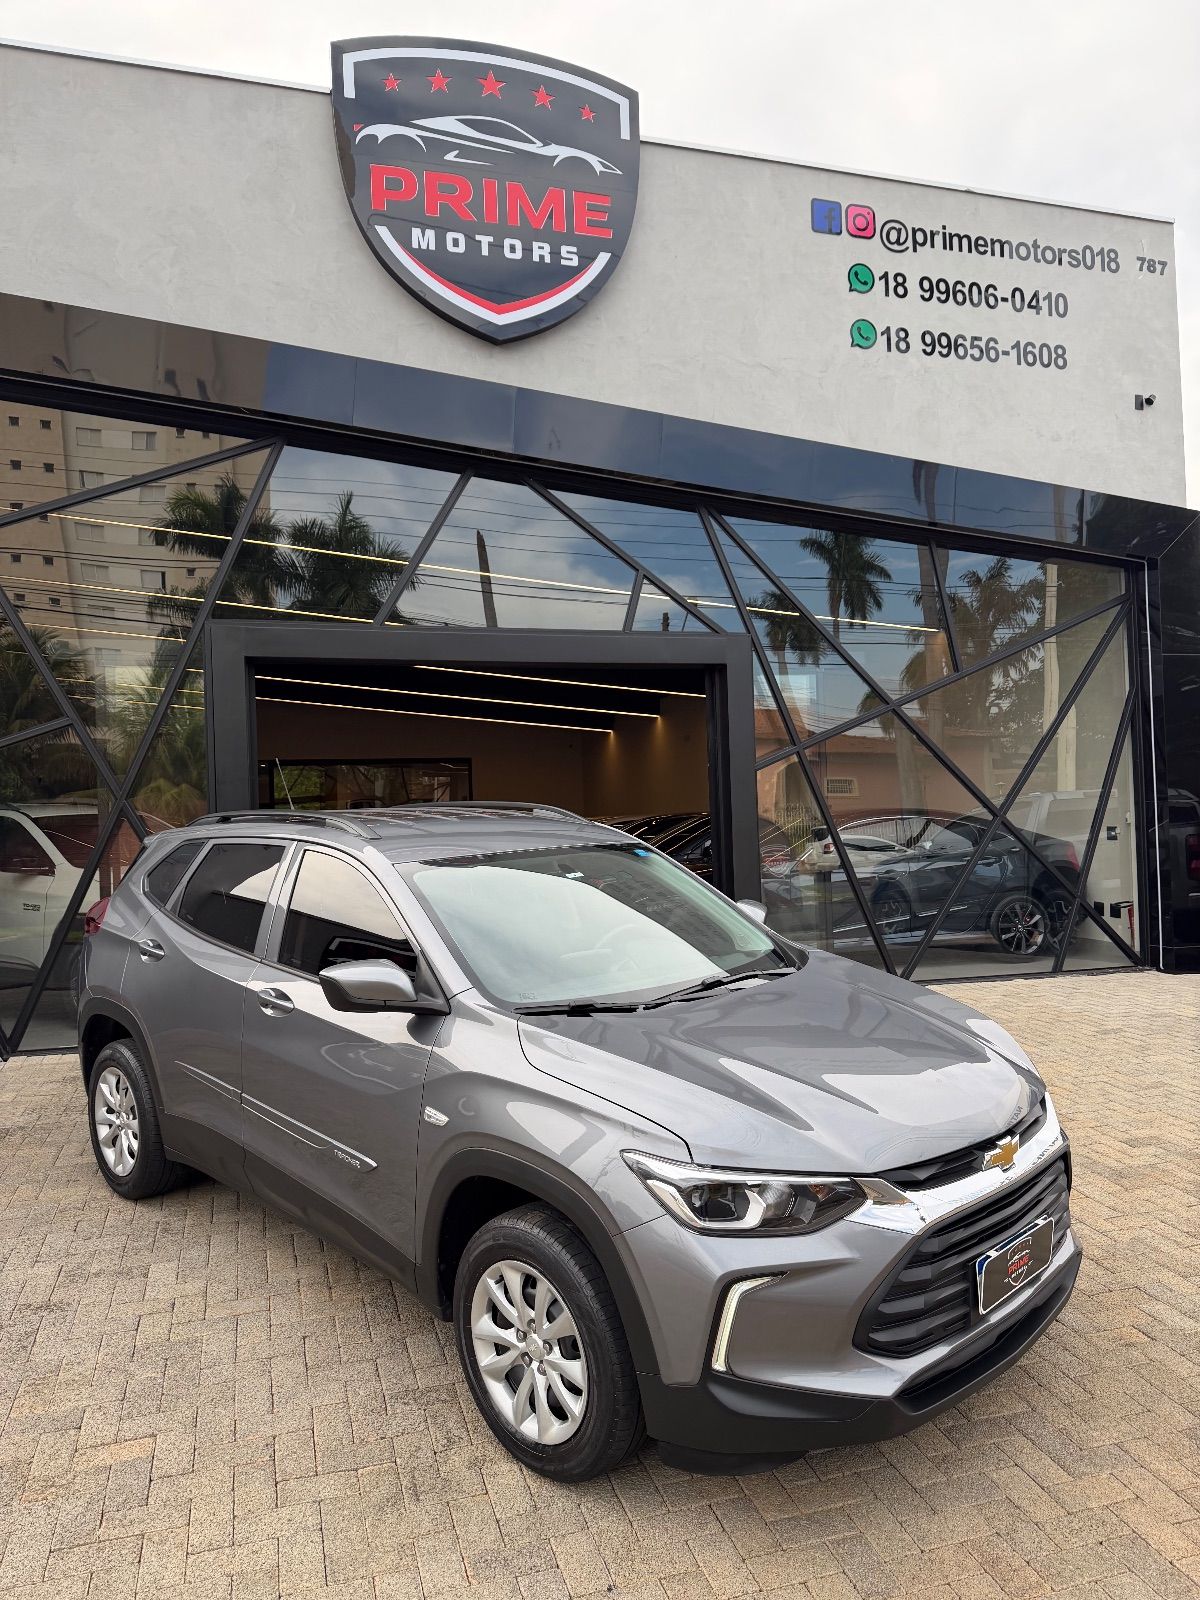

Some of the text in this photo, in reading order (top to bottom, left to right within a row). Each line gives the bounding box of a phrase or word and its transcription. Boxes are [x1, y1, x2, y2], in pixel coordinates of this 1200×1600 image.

[369, 163, 613, 239] PRIME
[411, 227, 579, 267] MOTORS
[880, 218, 1120, 274] @primemotors018
[1136, 255, 1168, 276] 787
[878, 270, 1069, 319] 18 99606-0410
[880, 325, 1068, 370] 18 99656-1608
